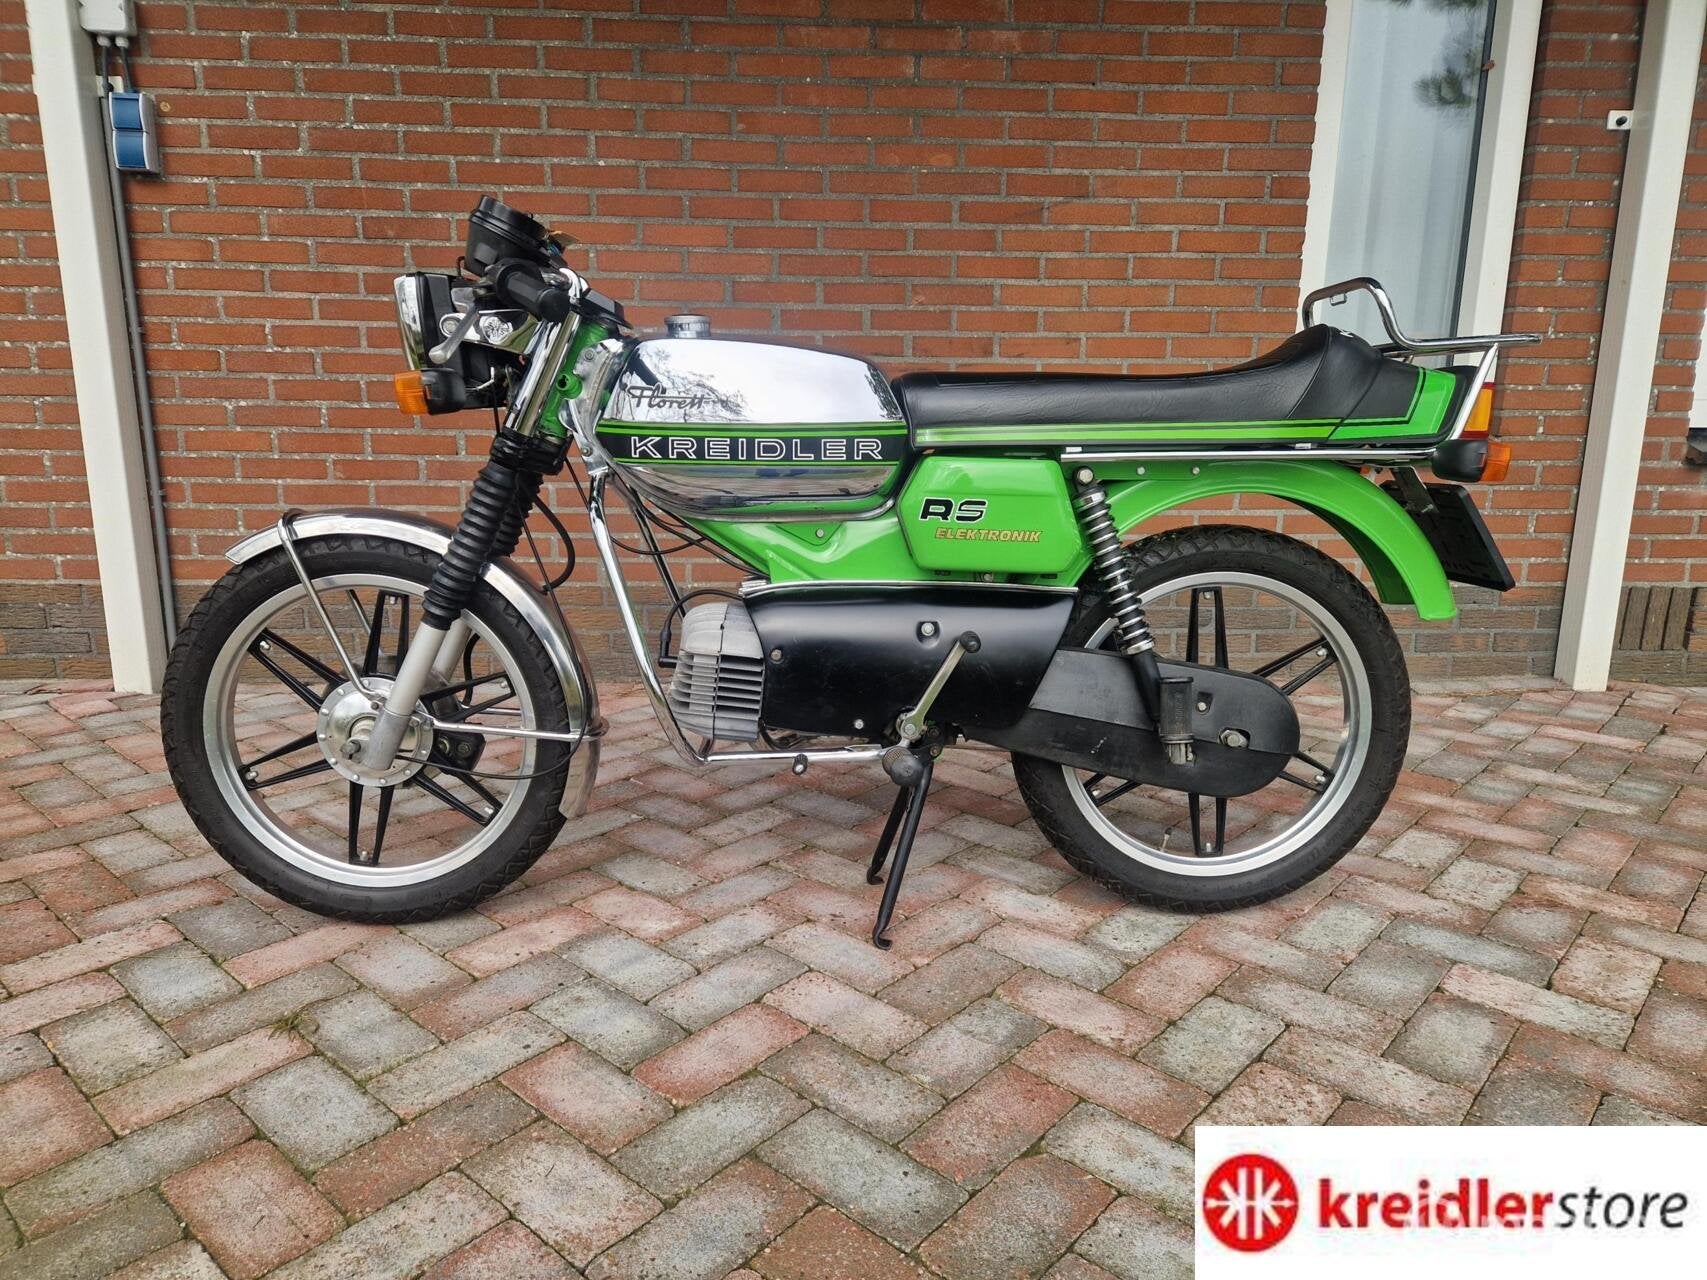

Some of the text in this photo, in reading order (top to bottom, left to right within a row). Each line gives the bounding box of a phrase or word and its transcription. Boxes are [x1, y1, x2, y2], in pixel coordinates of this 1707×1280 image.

[630, 436, 882, 460] KREIDLER
[919, 497, 988, 523] RS
[935, 528, 1042, 543] ELEKTRONIK
